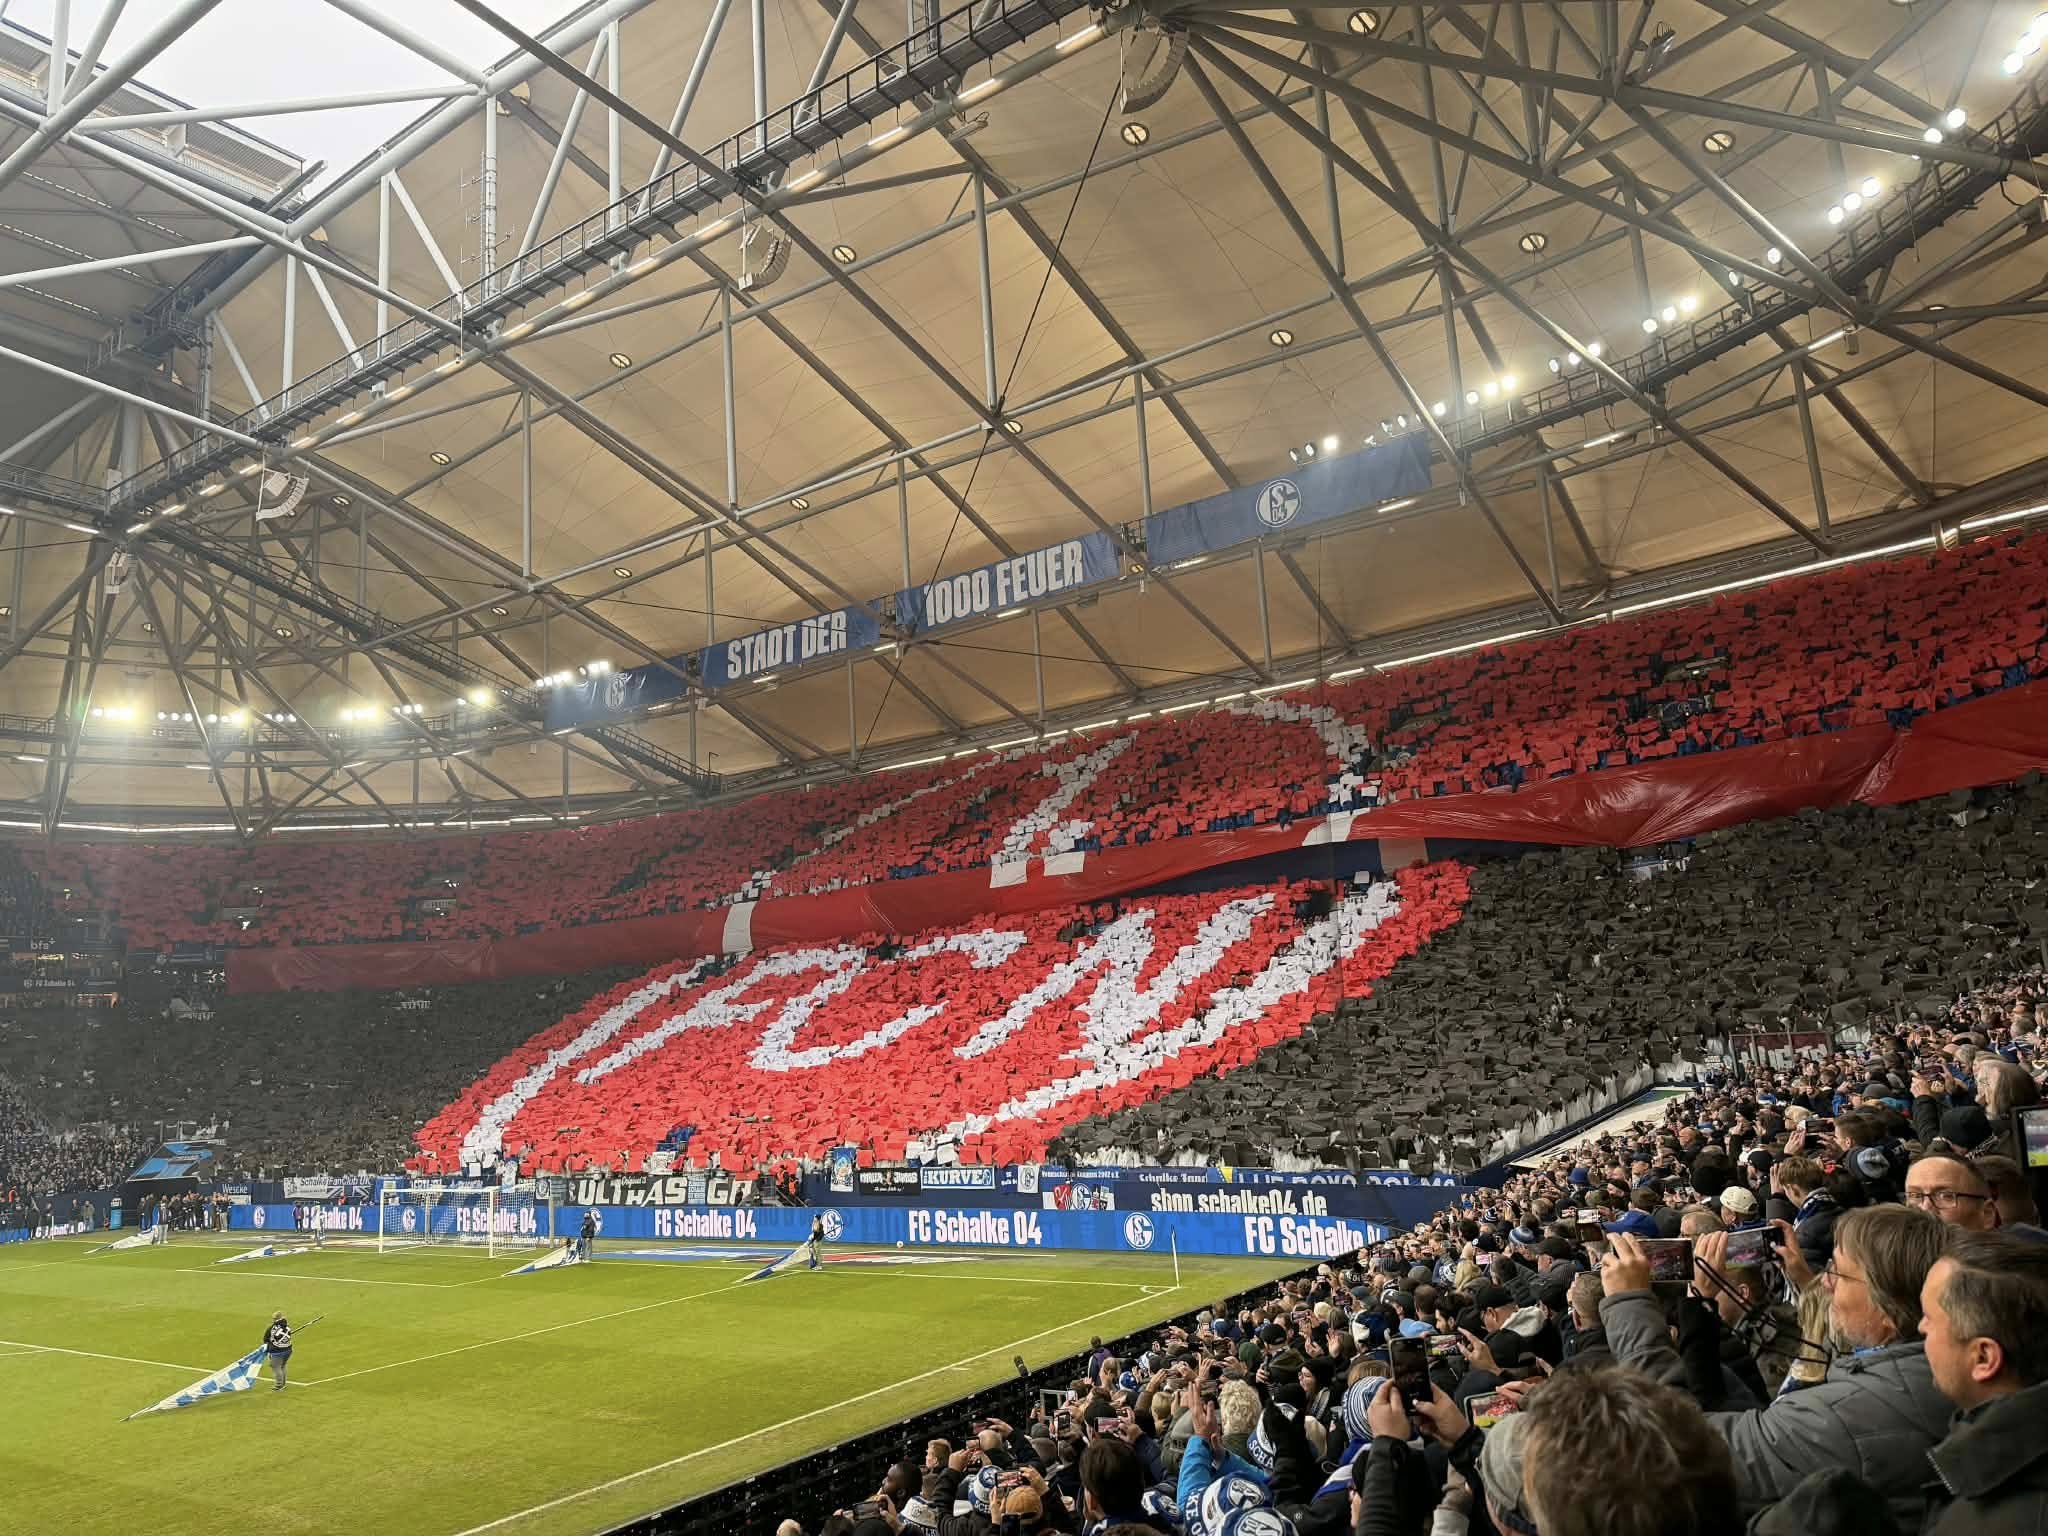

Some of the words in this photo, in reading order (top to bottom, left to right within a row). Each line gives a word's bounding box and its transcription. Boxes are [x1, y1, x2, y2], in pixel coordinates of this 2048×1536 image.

[924, 570, 990, 627] 1000
[996, 540, 1083, 606] FEUER
[727, 624, 797, 679] STADT
[801, 610, 847, 659] DER
[927, 1169, 983, 1185] KURVE
[1151, 1187, 1328, 1217] shop.schalke04.de
[349, 1207, 362, 1230] 04
[457, 1208, 470, 1232] FC
[520, 1208, 536, 1233] 04
[655, 1209, 672, 1237] FC
[675, 1209, 732, 1238] Schalke
[735, 1209, 757, 1238] 04
[909, 1210, 931, 1242] FC
[935, 1210, 1009, 1244] Schalke
[1014, 1211, 1042, 1245] 04
[1244, 1216, 1274, 1254] FC
[1279, 1217, 1364, 1258] Schalke
